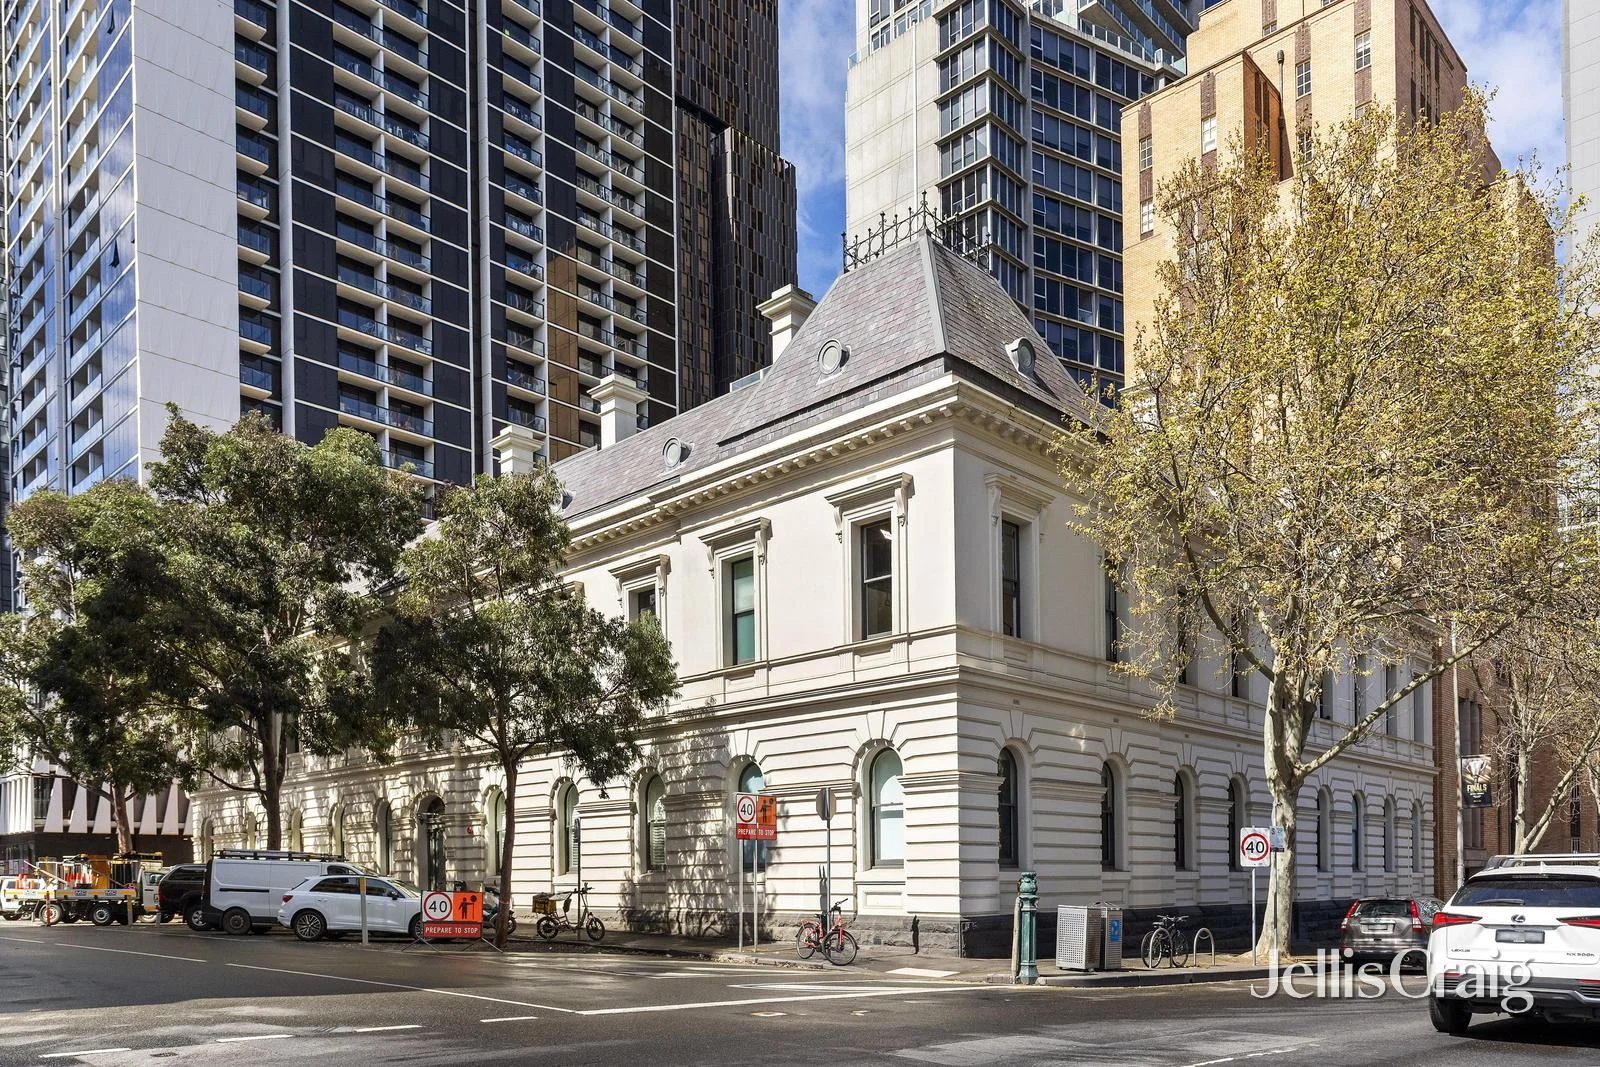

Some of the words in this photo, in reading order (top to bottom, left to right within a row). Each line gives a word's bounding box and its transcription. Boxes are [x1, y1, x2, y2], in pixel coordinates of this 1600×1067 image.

[1467, 784, 1487, 792] FINALS
[741, 804, 752, 815] 40
[1246, 841, 1264, 853] 40
[429, 901, 447, 912] 40
